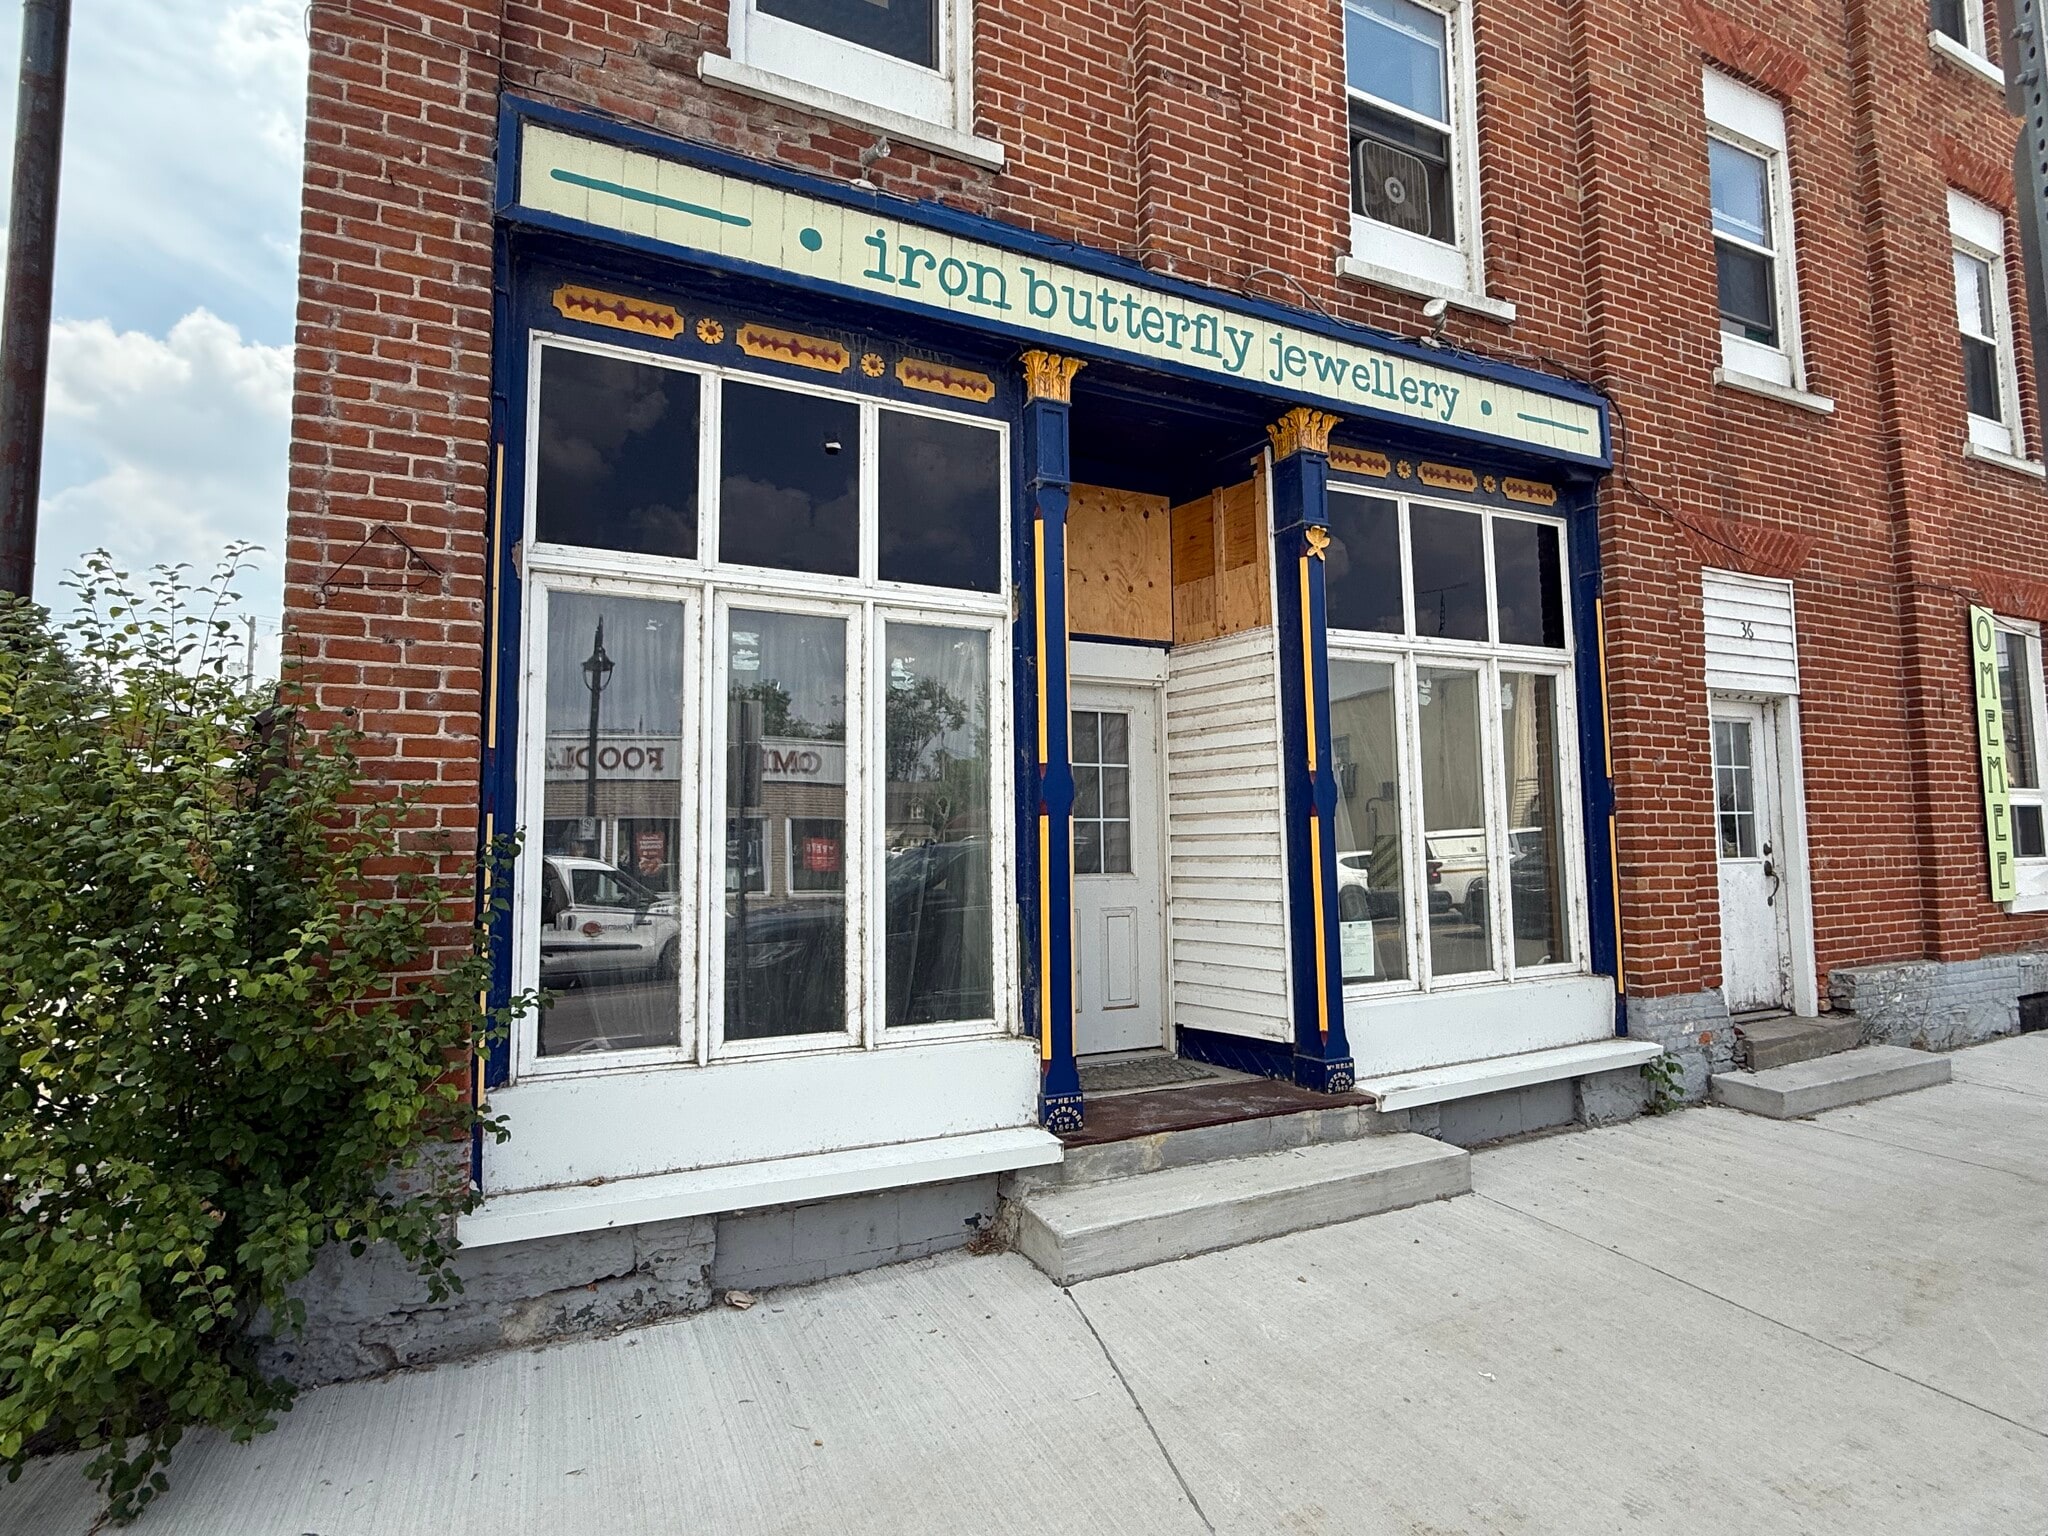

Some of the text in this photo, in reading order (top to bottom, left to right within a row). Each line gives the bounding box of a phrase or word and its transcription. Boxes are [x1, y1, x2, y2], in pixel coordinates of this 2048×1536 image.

[863, 228, 1461, 421] iron butterfly jewellery
[1740, 621, 1754, 640] 36
[1058, 1096, 1082, 1104] HELM
